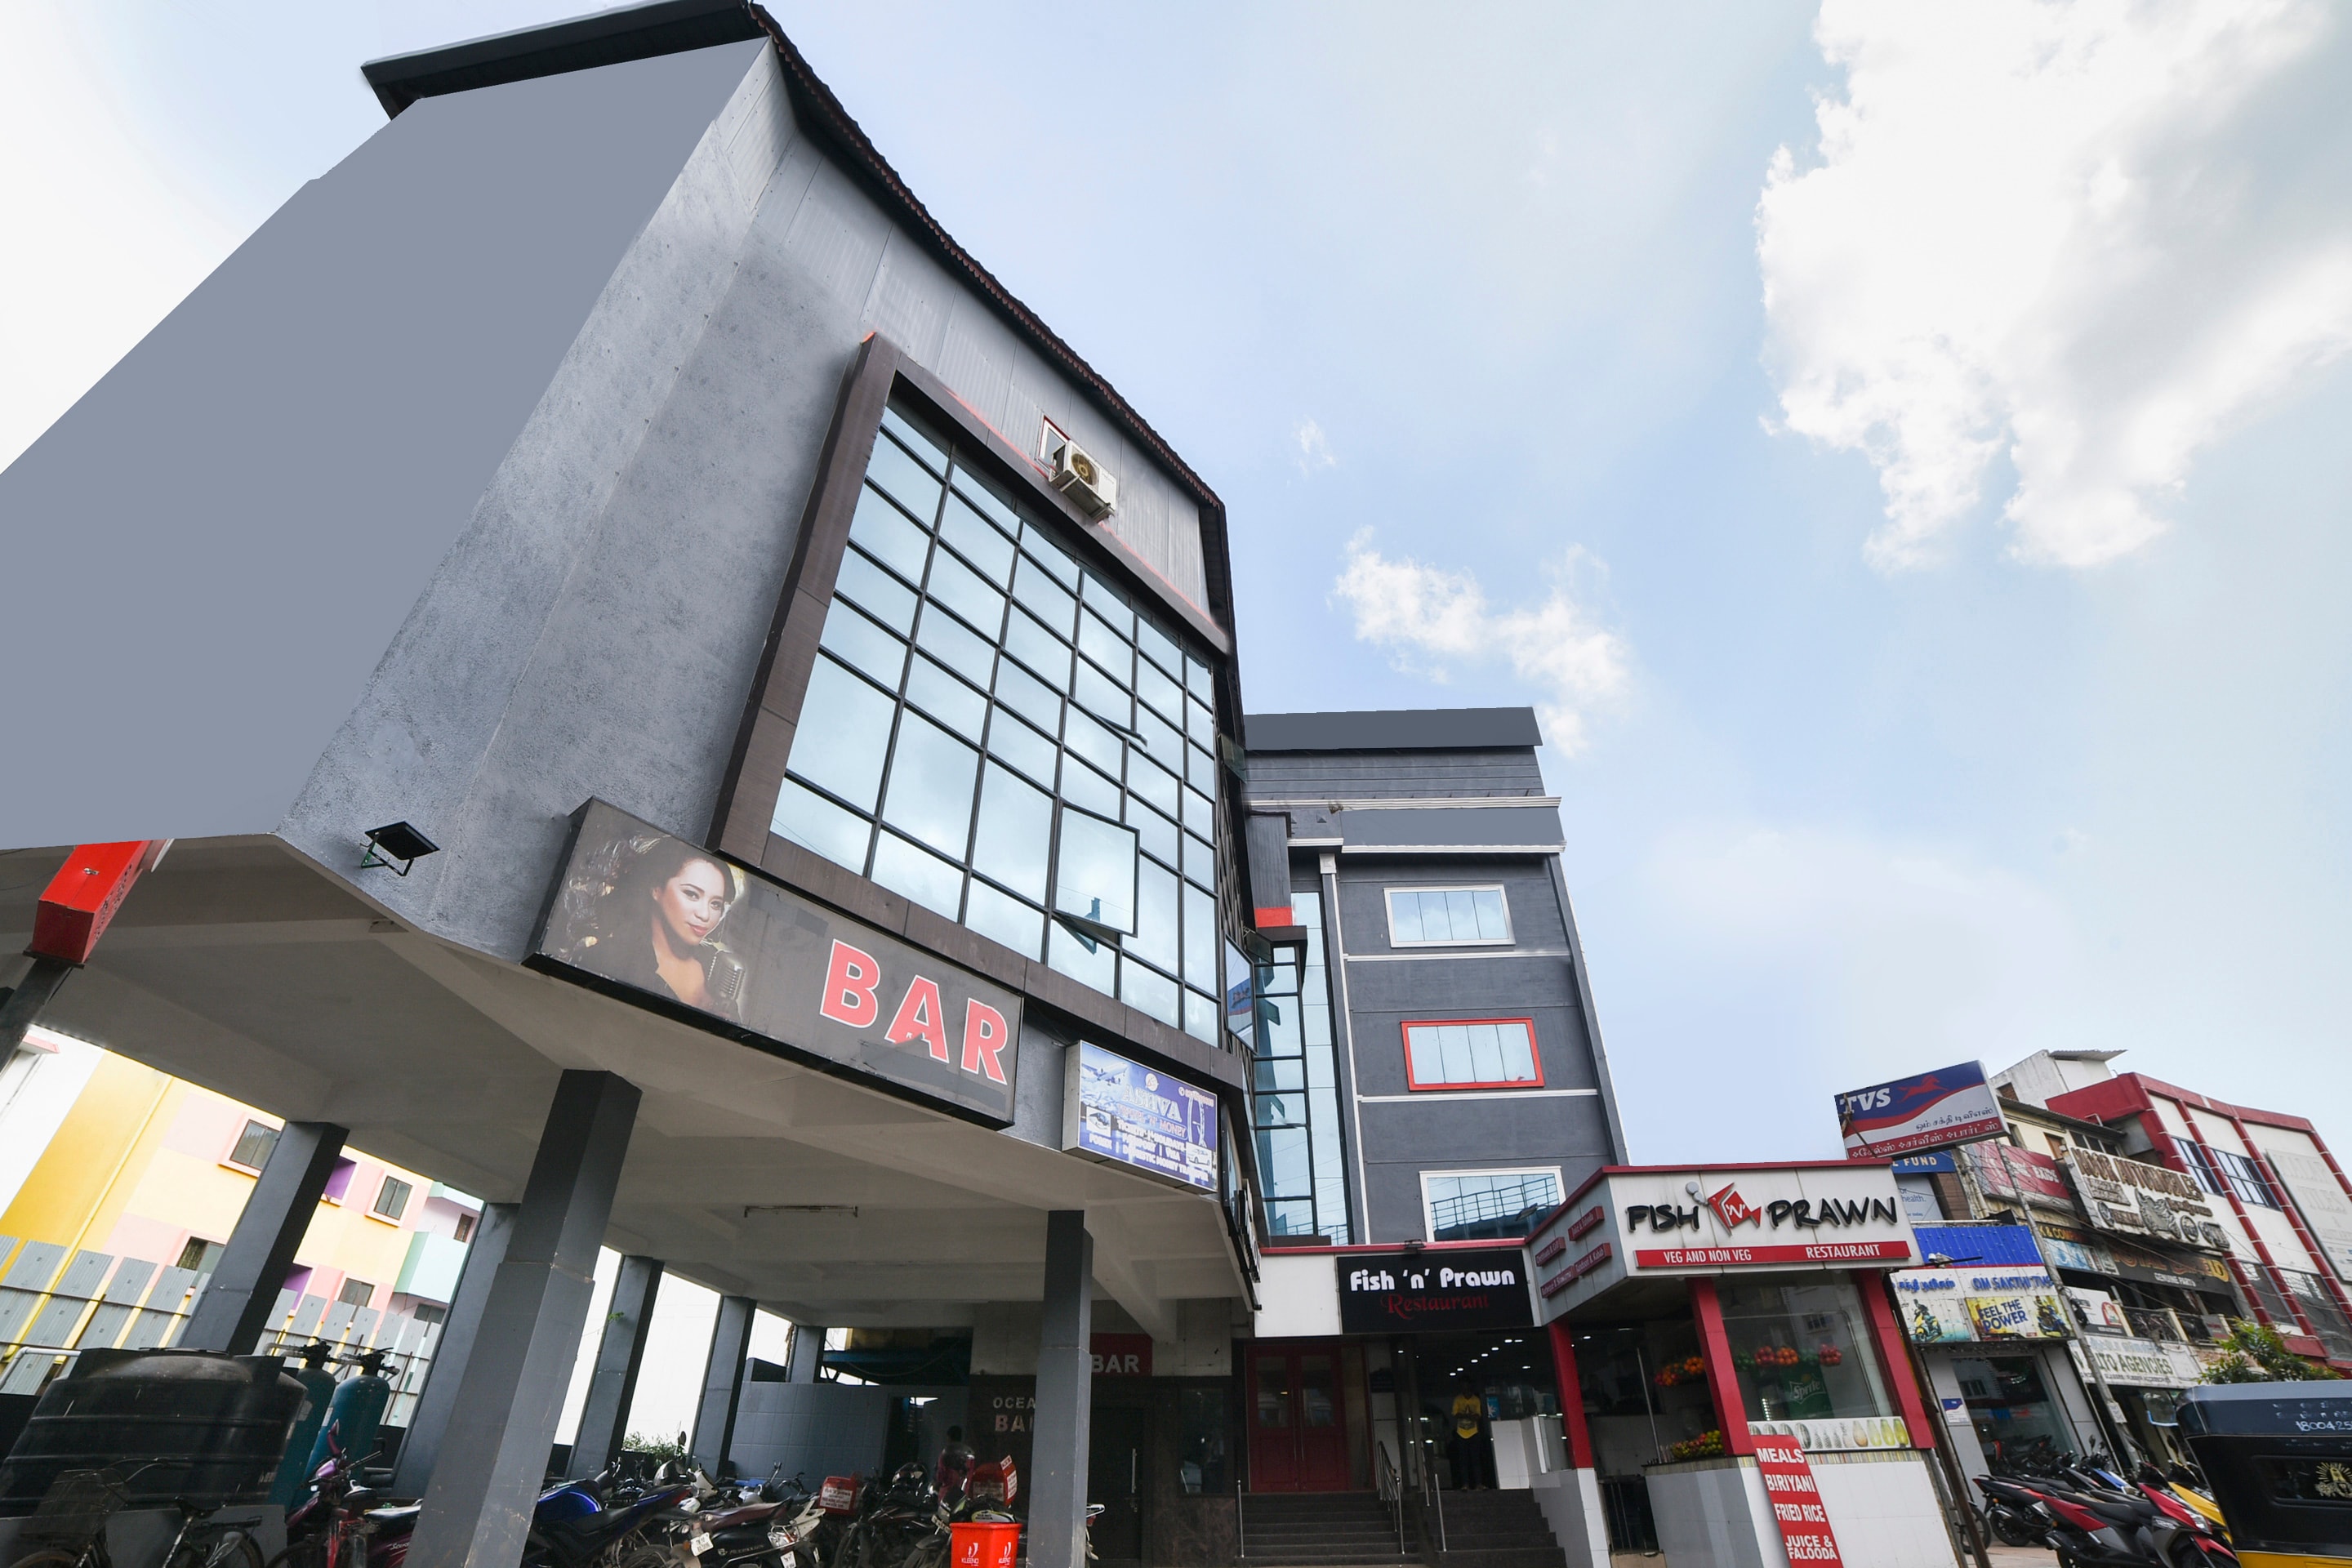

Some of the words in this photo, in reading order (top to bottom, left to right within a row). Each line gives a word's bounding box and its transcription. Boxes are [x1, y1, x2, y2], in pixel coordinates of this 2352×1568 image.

[819, 938, 1008, 1085] BAR
[1839, 1088, 1891, 1114] TVS
[1160, 1120, 1187, 1138] MONEY
[1903, 1156, 1937, 1167] FUND
[1625, 1204, 1700, 1233] FISH
[1766, 1196, 1898, 1230] PRAWN
[1664, 1251, 1684, 1263] VEG
[1686, 1250, 1706, 1263] AND
[1708, 1250, 1731, 1262] NON
[1732, 1249, 1752, 1261] VEG
[1806, 1244, 1881, 1259] RESTAURANT
[1350, 1269, 1395, 1291] Fish
[1440, 1267, 1515, 1288] Prawn
[1973, 1277, 1992, 1290] OM
[1993, 1276, 2031, 1290] SAKTHI
[2031, 1275, 2054, 1288] TVS
[1380, 1294, 1490, 1320] Restaurant
[1978, 1305, 2002, 1320] FEEL
[2001, 1299, 2023, 1313] THE
[1982, 1310, 2029, 1332] POWER
[1091, 1354, 1140, 1373] BAR
[2118, 1354, 2174, 1375] AGENCIES
[993, 1397, 1036, 1409] OCEA
[1756, 1448, 1805, 1463] MEALS
[1774, 1503, 1802, 1521] FRIED
[1802, 1504, 1826, 1522] RICE
[1786, 1535, 1820, 1548] JUICE
[1824, 1535, 1833, 1547] &
[1788, 1548, 1838, 1560] FALOODA
